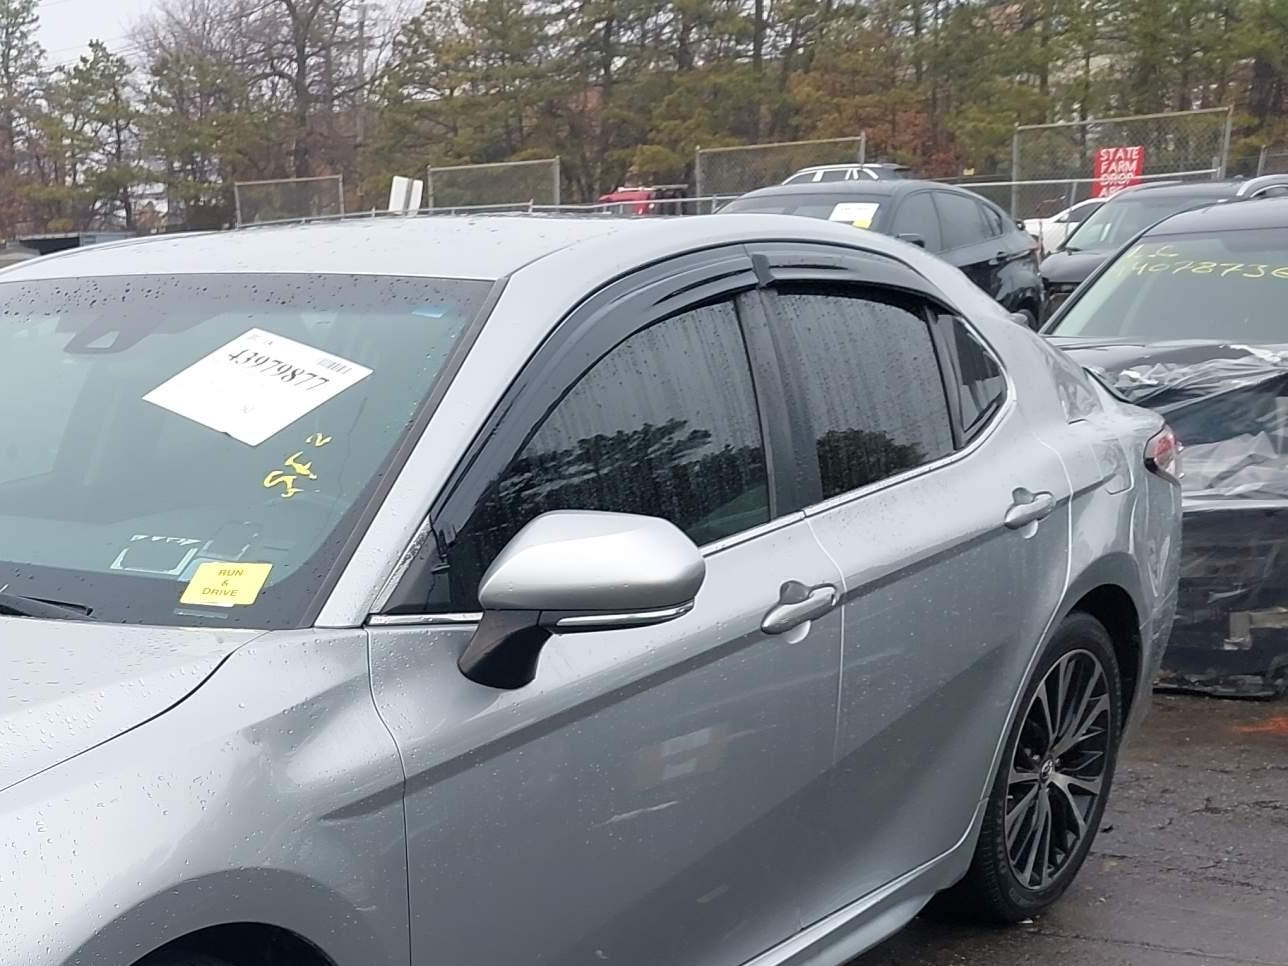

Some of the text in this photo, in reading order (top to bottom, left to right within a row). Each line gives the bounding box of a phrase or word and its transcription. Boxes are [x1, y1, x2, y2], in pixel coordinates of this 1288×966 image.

[1100, 146, 1140, 161] STATE
[1100, 160, 1138, 174] FARM
[228, 349, 330, 391] 43979877
[217, 569, 245, 577] RUN
[201, 587, 239, 597] DRIVE
